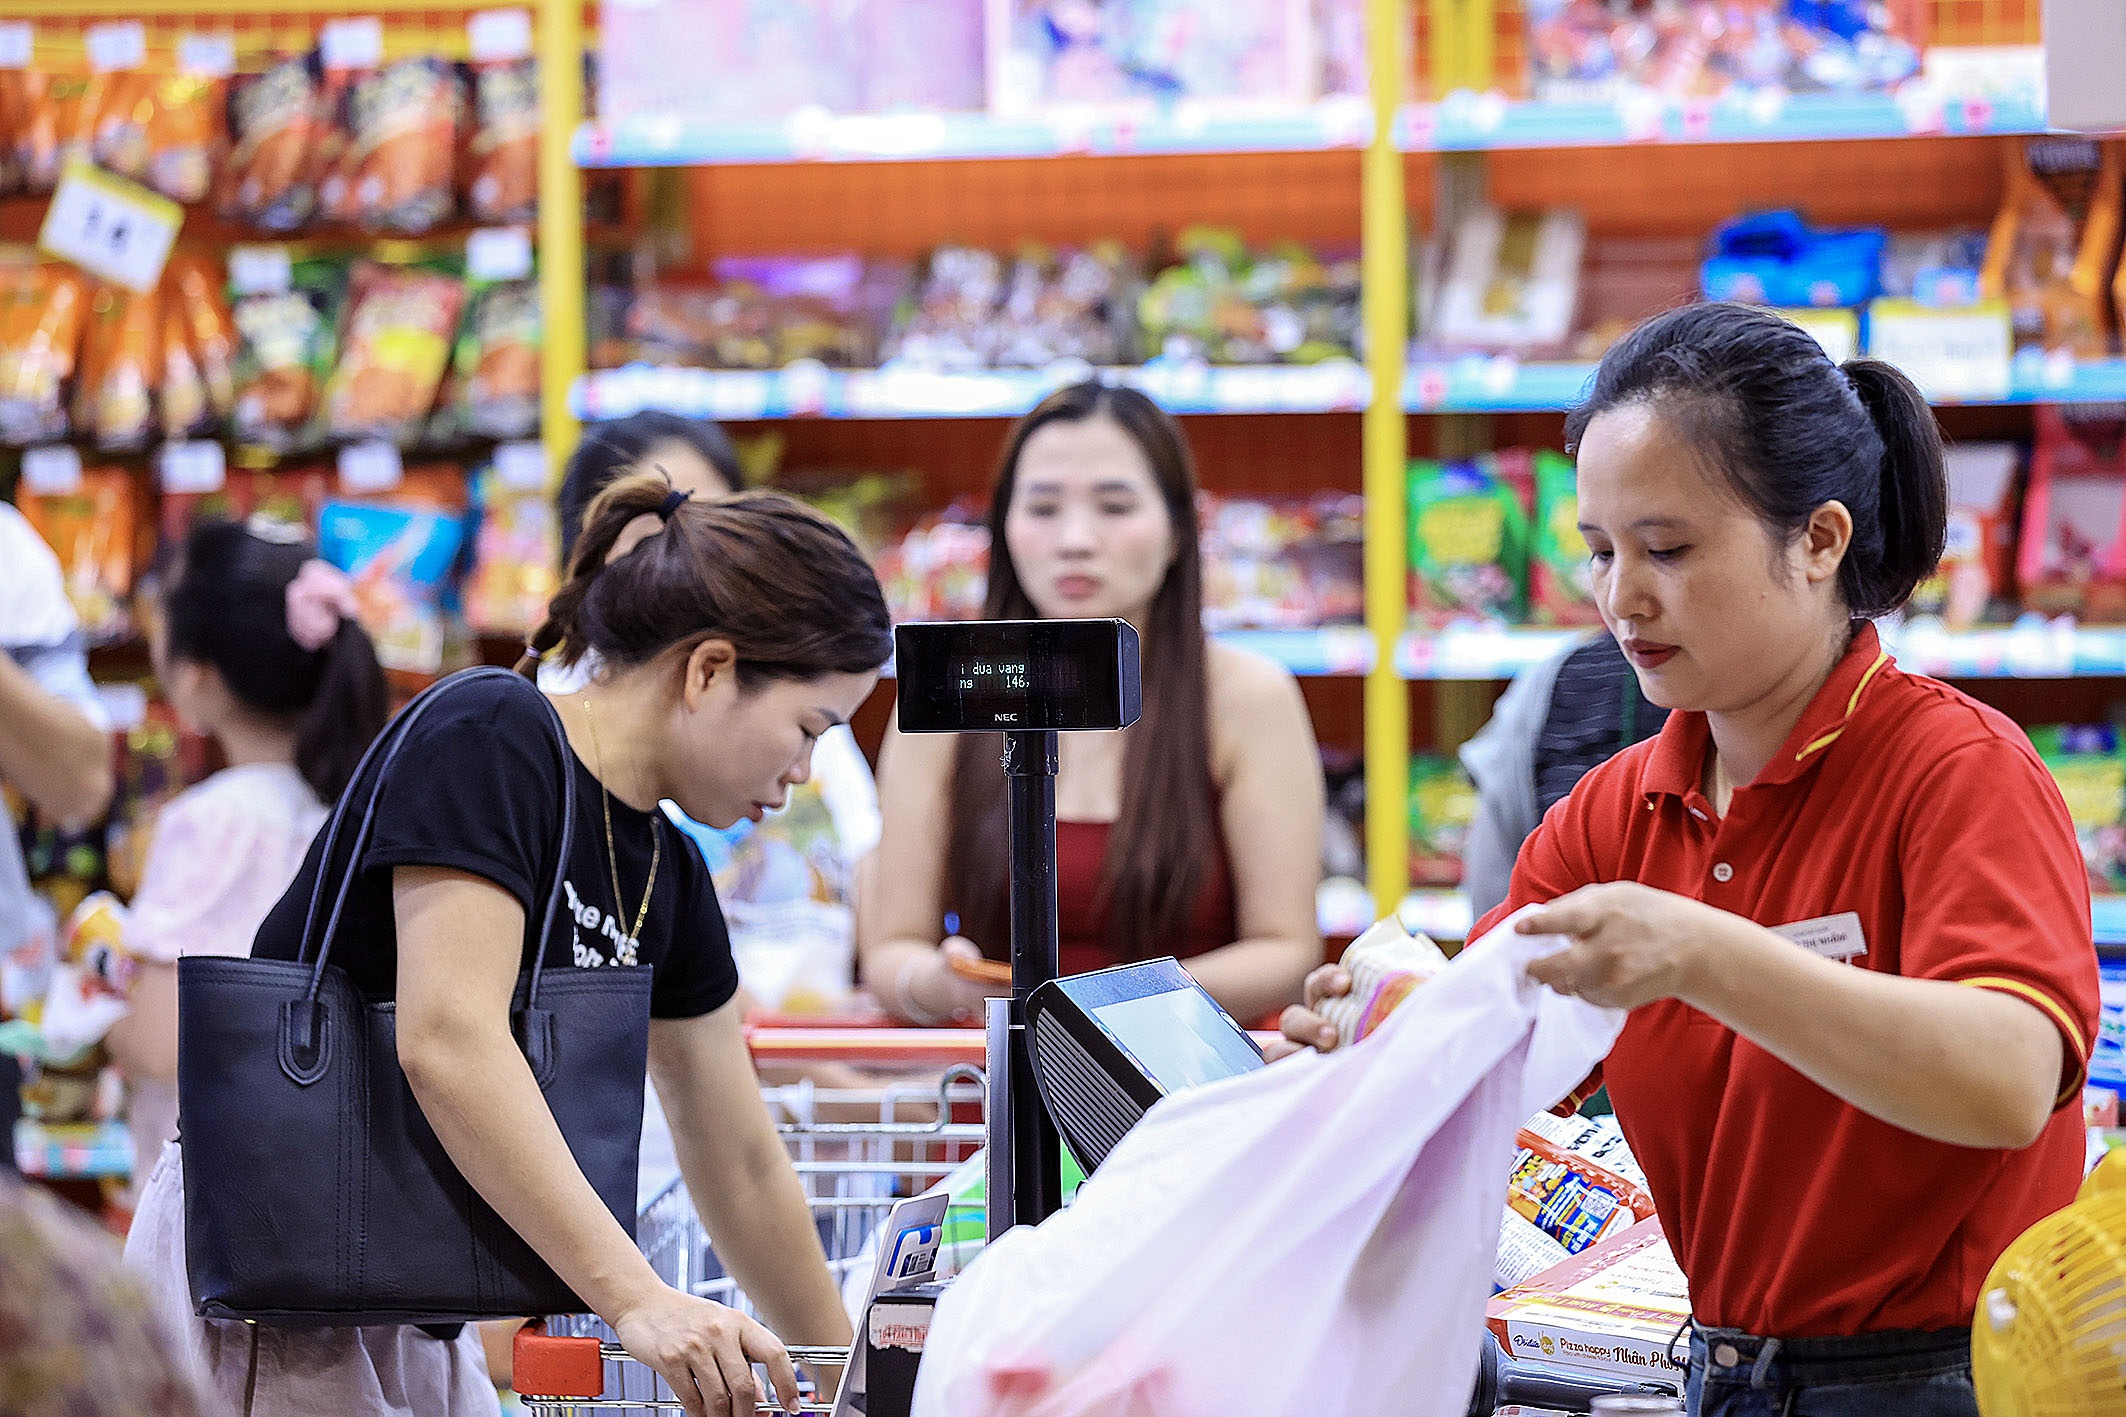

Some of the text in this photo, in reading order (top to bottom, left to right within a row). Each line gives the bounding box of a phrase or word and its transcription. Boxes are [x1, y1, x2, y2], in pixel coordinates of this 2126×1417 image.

[972, 661, 993, 675] dua
[998, 663, 1025, 674] vang
[994, 713, 1018, 722] NEC
[1560, 1337, 1584, 1352] Pizza
[1584, 1343, 1611, 1358] happy
[1612, 1346, 1648, 1367] Nhân
